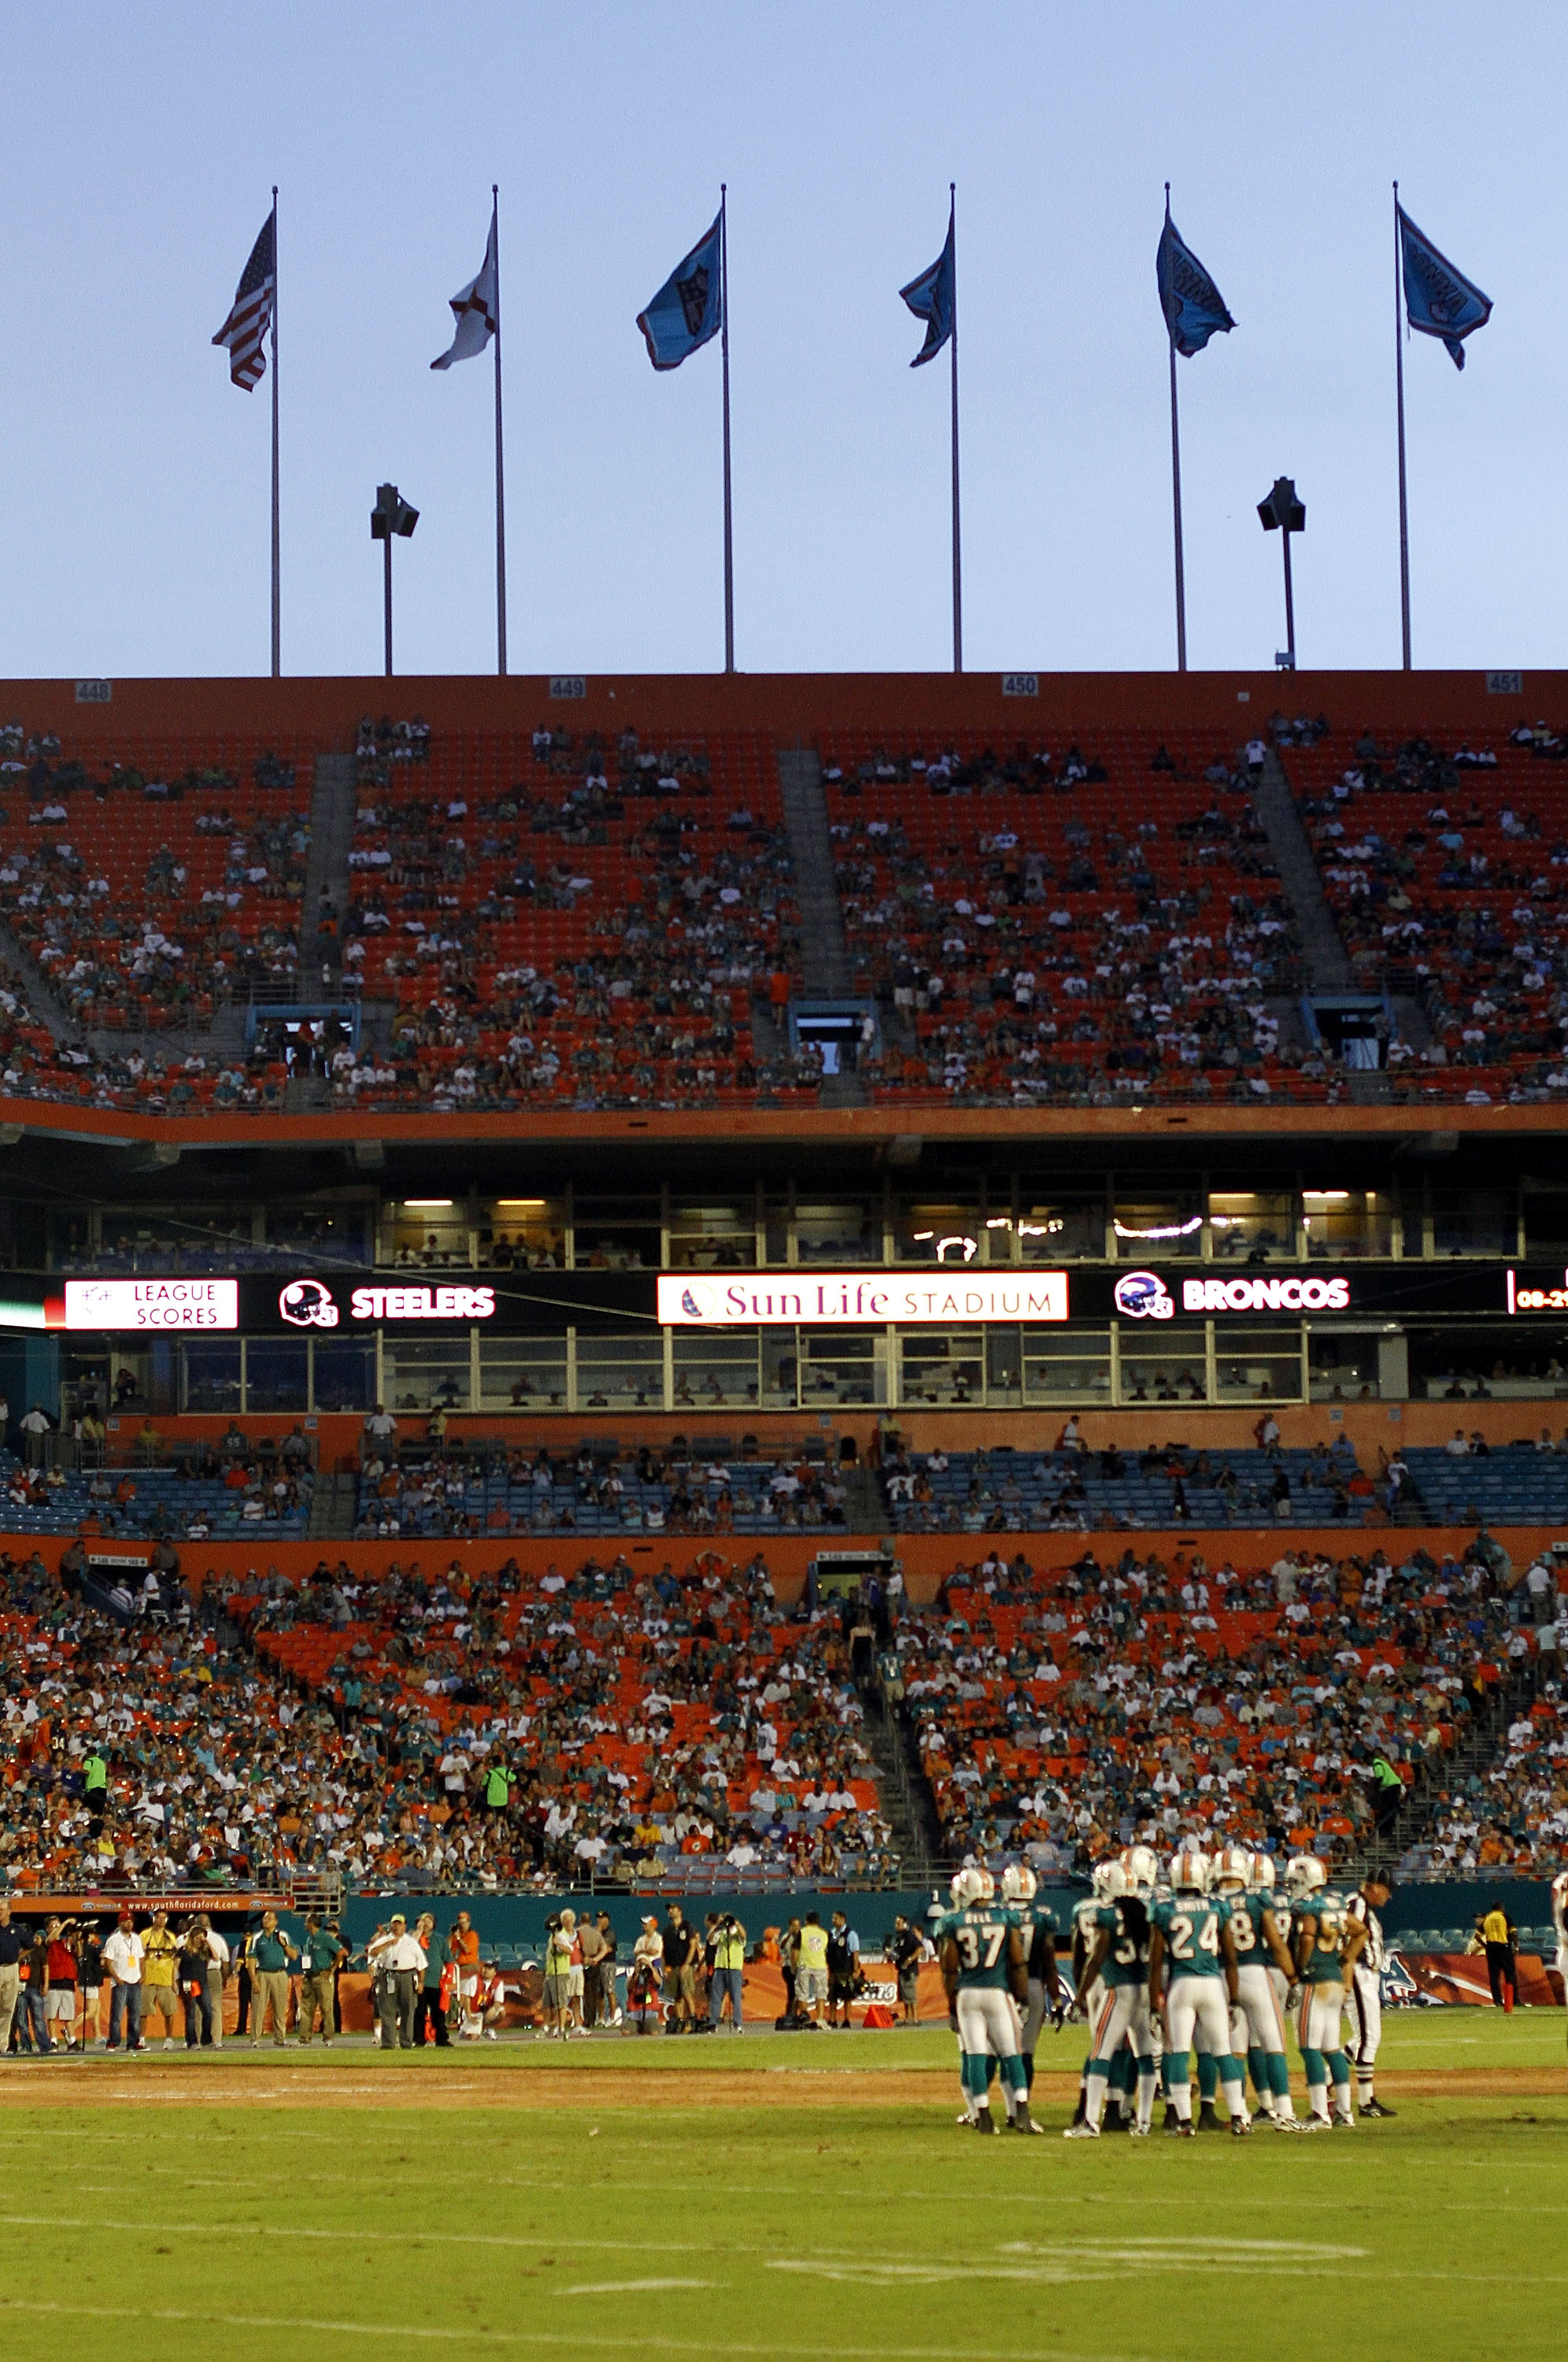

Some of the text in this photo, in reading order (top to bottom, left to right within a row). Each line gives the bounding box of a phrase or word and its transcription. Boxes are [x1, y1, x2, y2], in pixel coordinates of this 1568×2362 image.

[1007, 676, 1035, 693] 450
[135, 1285, 216, 1301] LEAGUE
[351, 1286, 497, 1319] STEELERS
[727, 1282, 1051, 1316] Sun Life STADIUM
[1183, 1277, 1350, 1311] BRONCOS
[137, 1308, 216, 1324] SCORES
[128, 1900, 239, 1910] www.southfloridaford.com
[956, 1923, 1006, 1969] 37
[1170, 1914, 1219, 1959] 24
